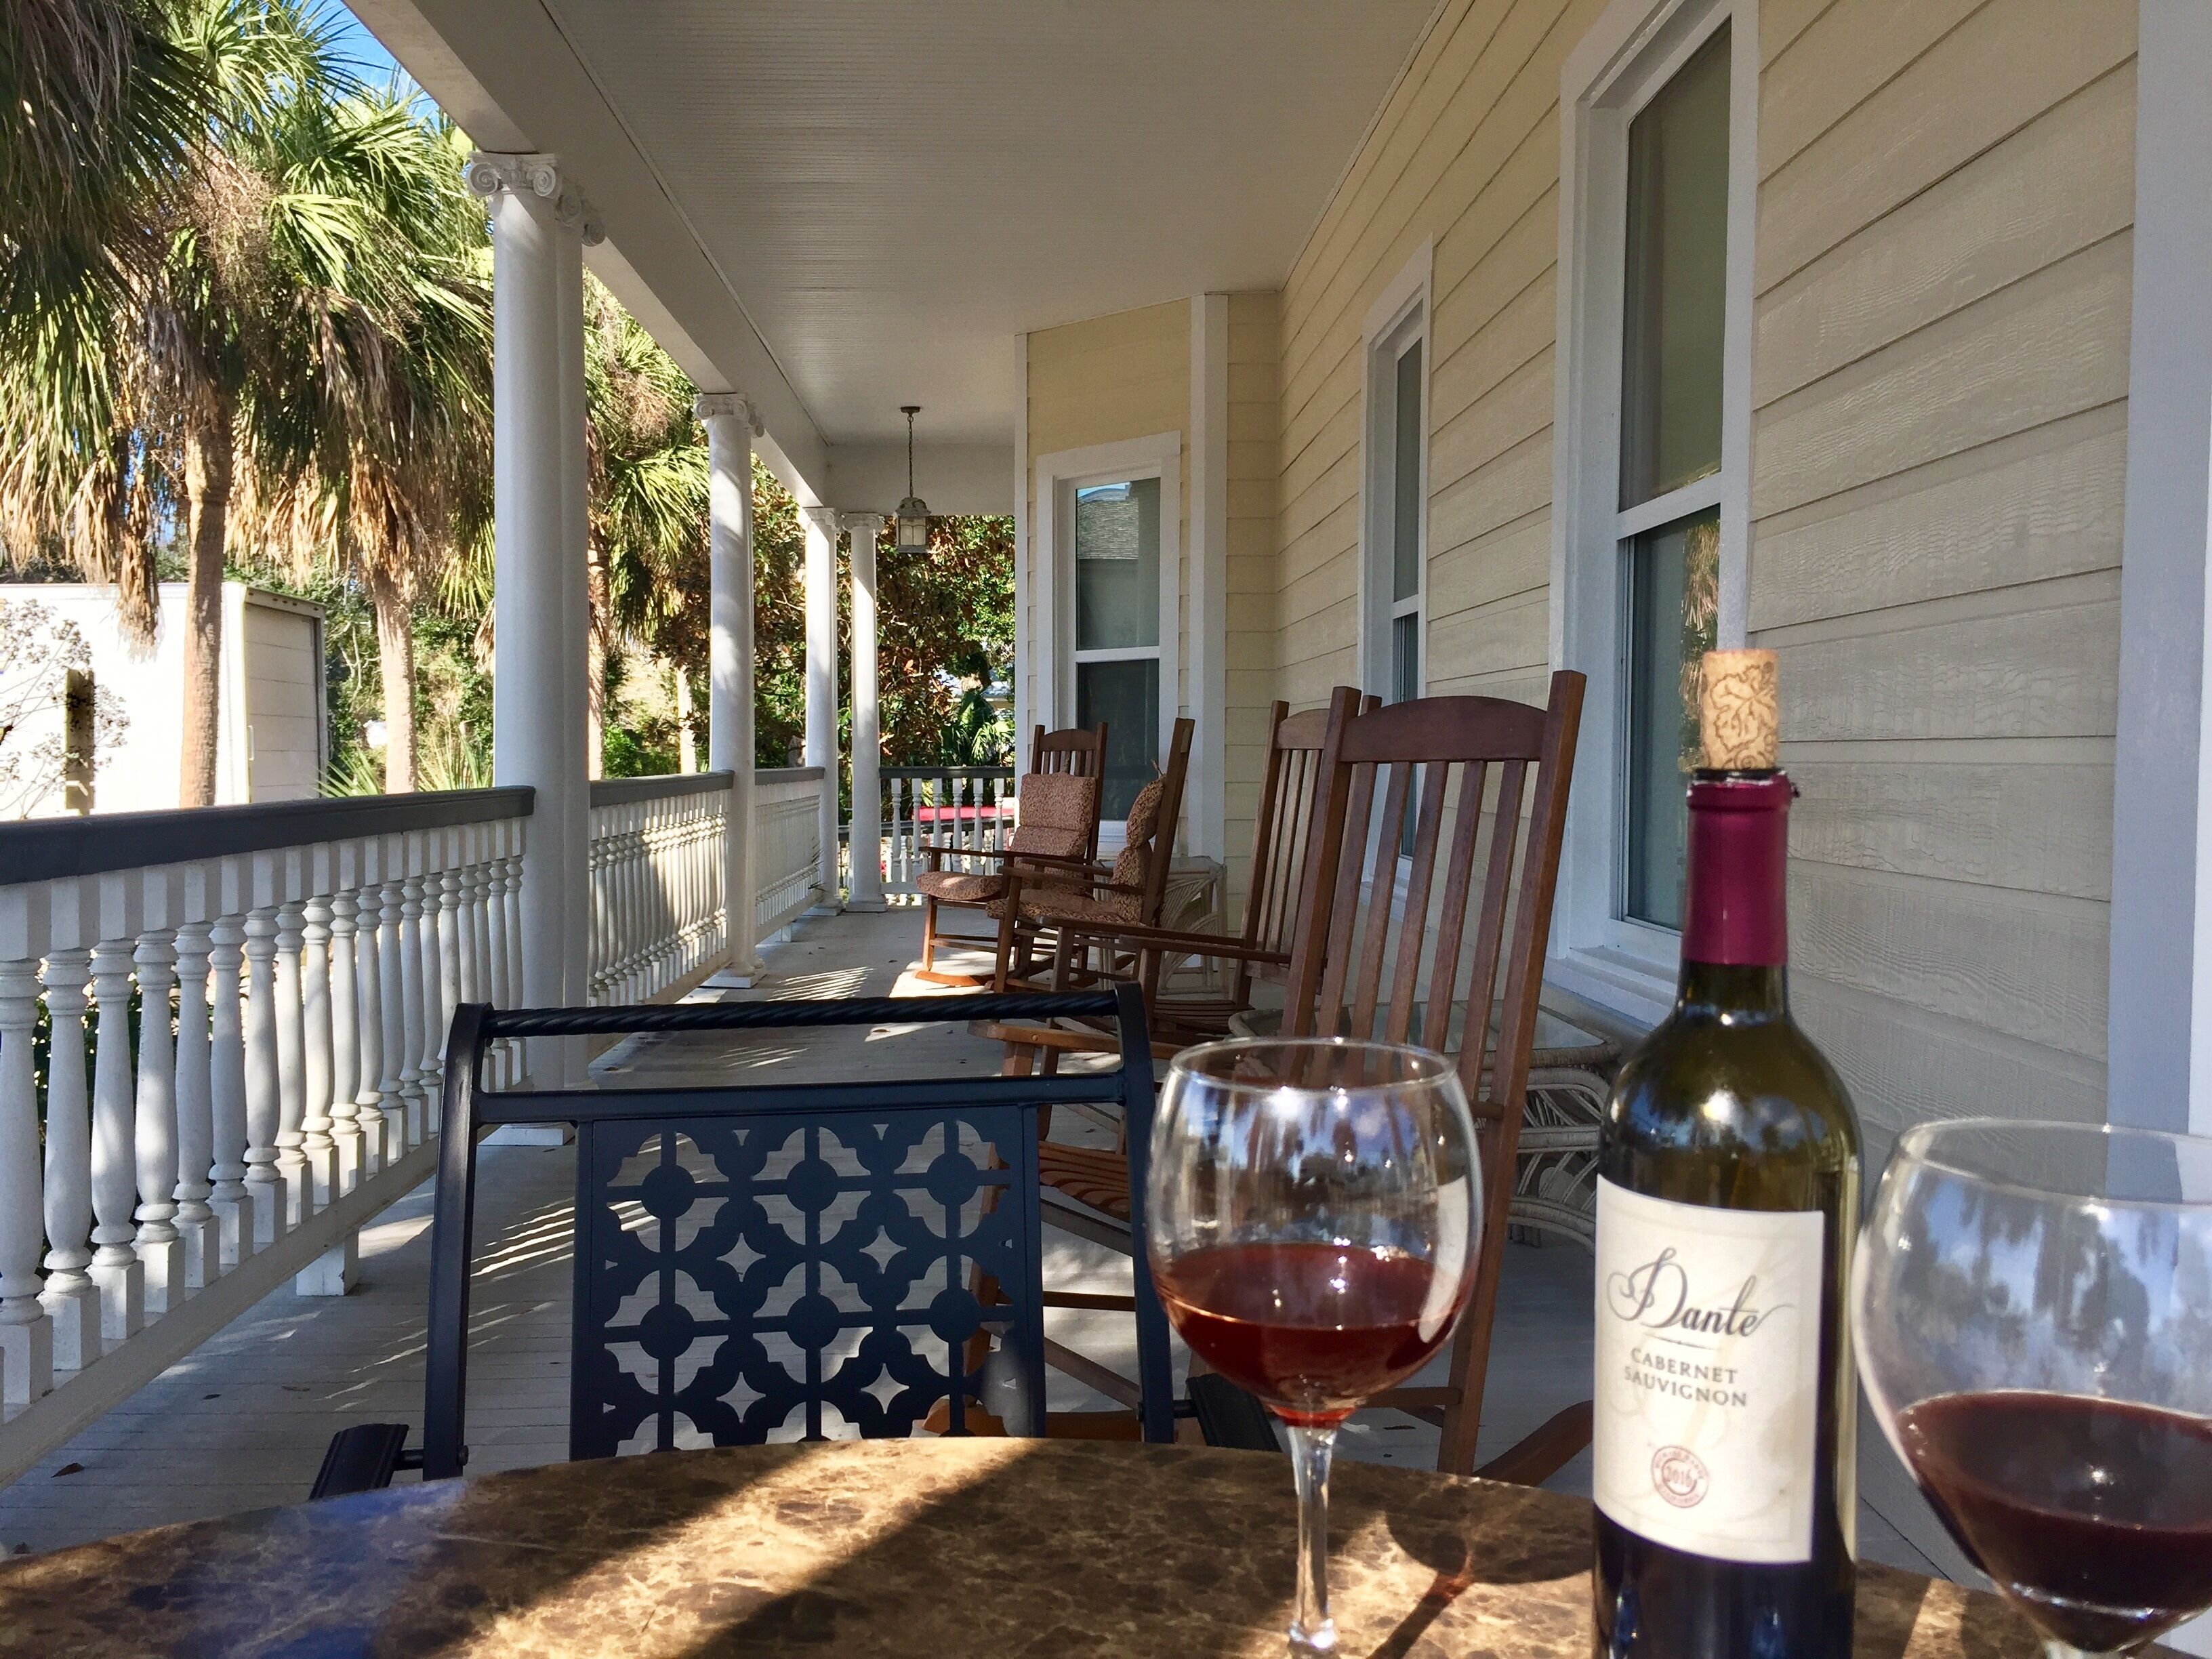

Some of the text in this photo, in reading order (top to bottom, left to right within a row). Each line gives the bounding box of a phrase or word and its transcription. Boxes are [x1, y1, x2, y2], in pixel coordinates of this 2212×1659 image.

[1605, 1246, 1796, 1337] Dante
[1630, 1347, 1738, 1384] CABERNET
[1624, 1366, 1747, 1406] SAUVIGNON
